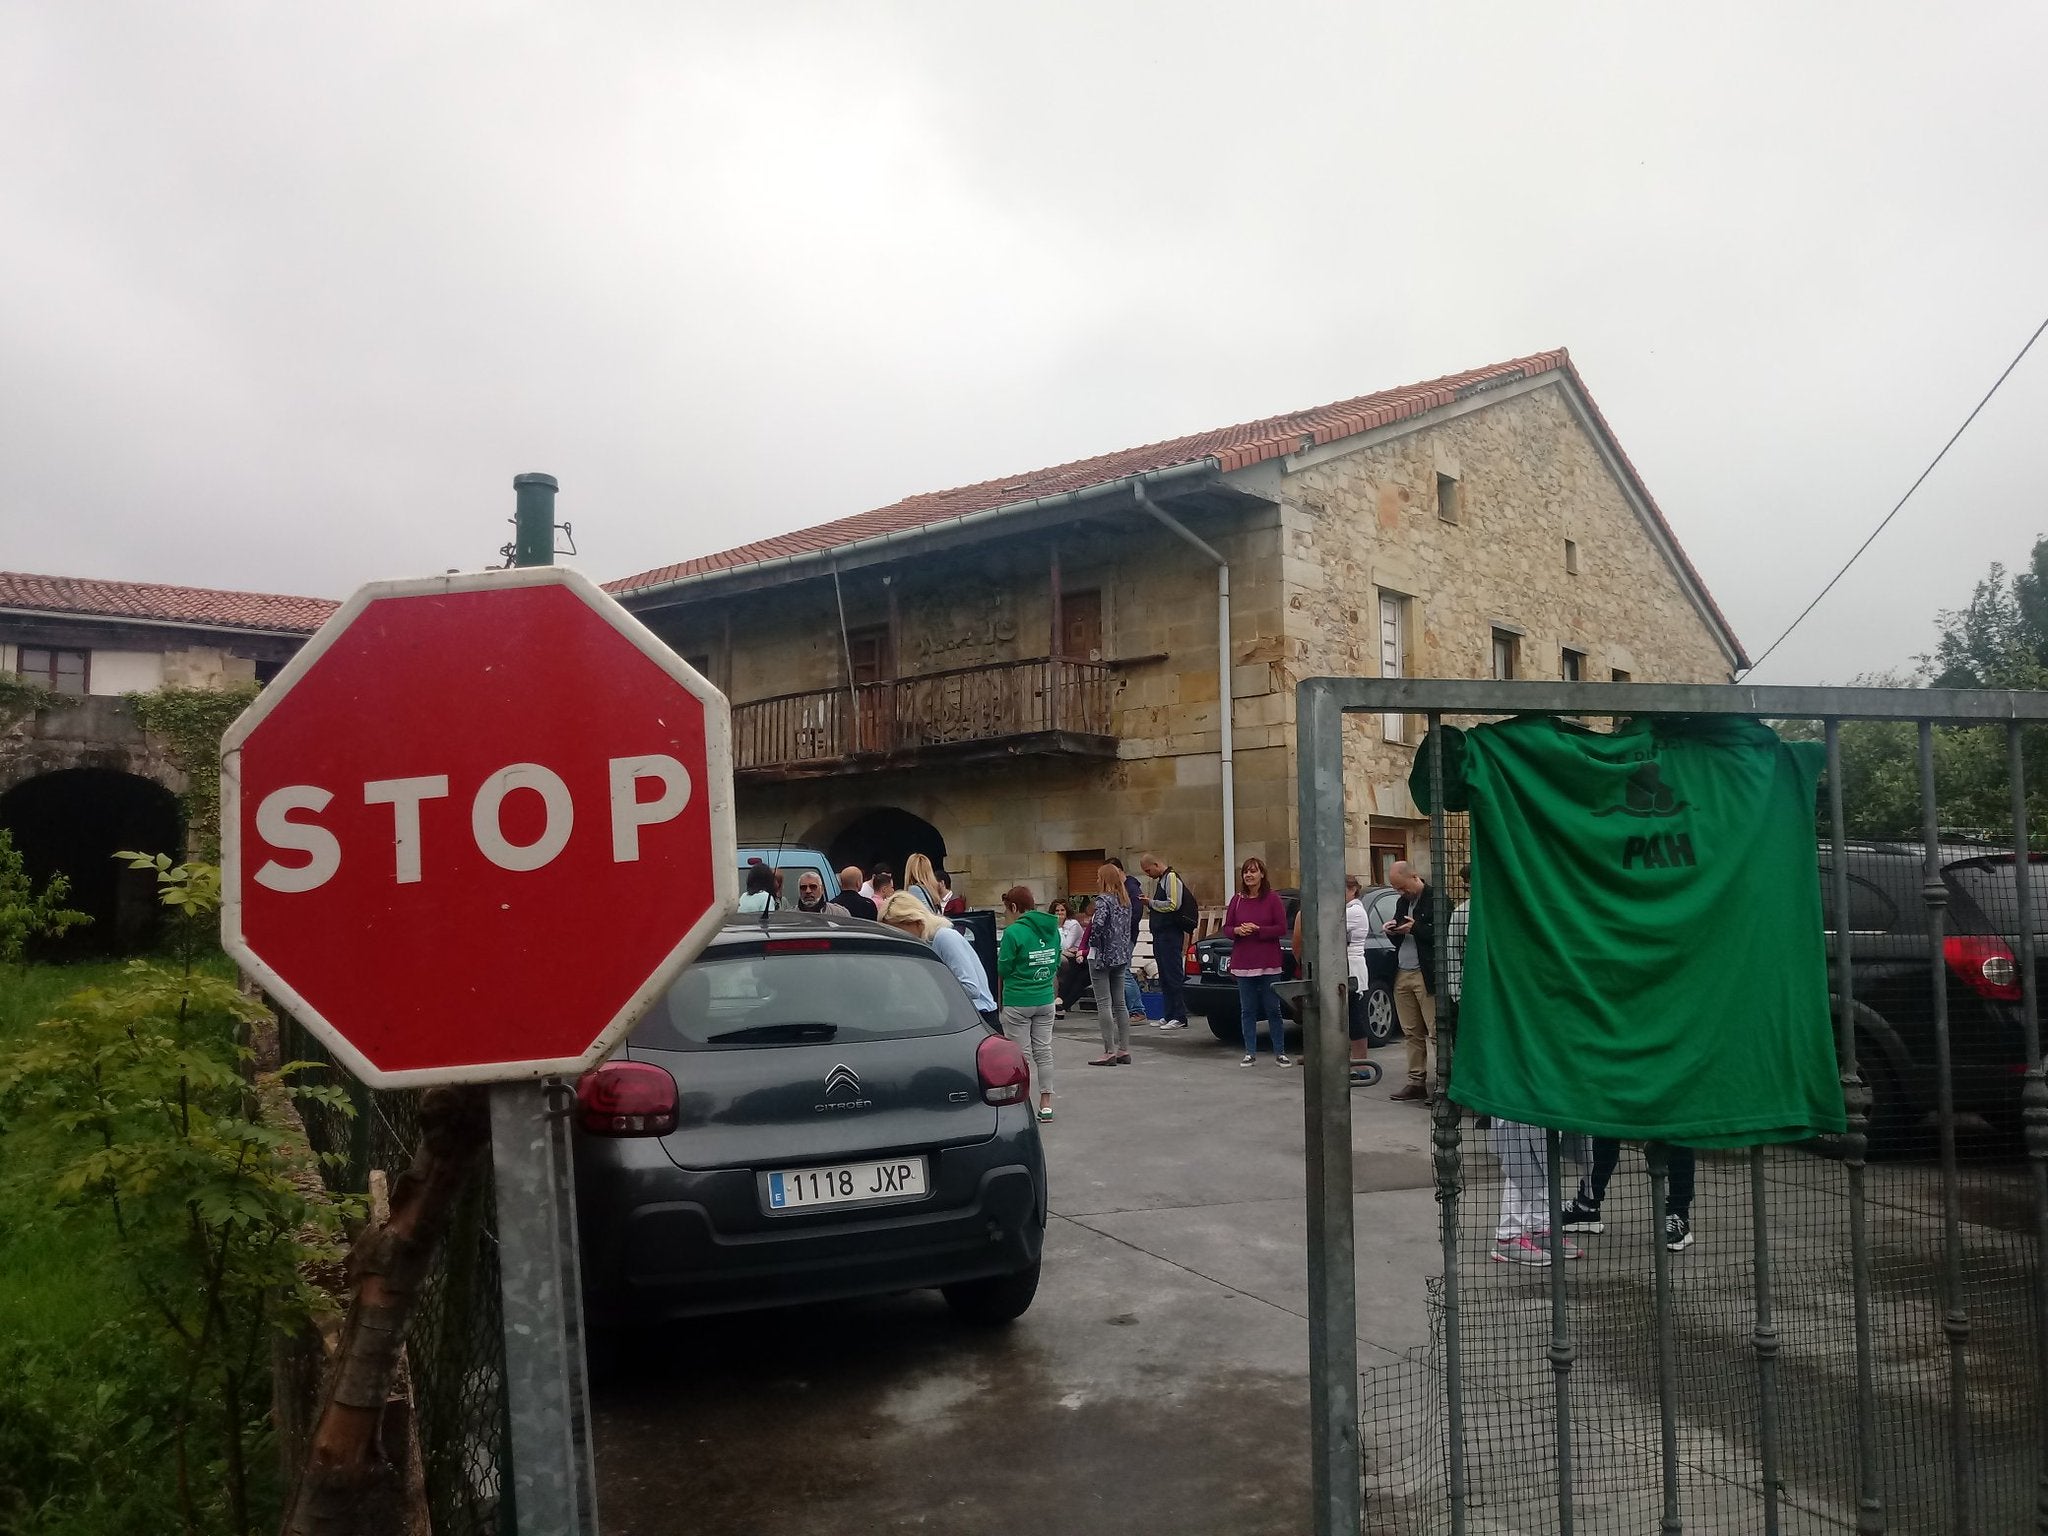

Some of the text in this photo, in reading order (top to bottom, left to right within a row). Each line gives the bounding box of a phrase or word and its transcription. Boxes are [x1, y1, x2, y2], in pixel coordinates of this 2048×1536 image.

[253, 754, 692, 893] STOP
[1622, 832, 1697, 870] PAH
[794, 1170, 854, 1201] 1118
[869, 1164, 911, 1194] JXP
